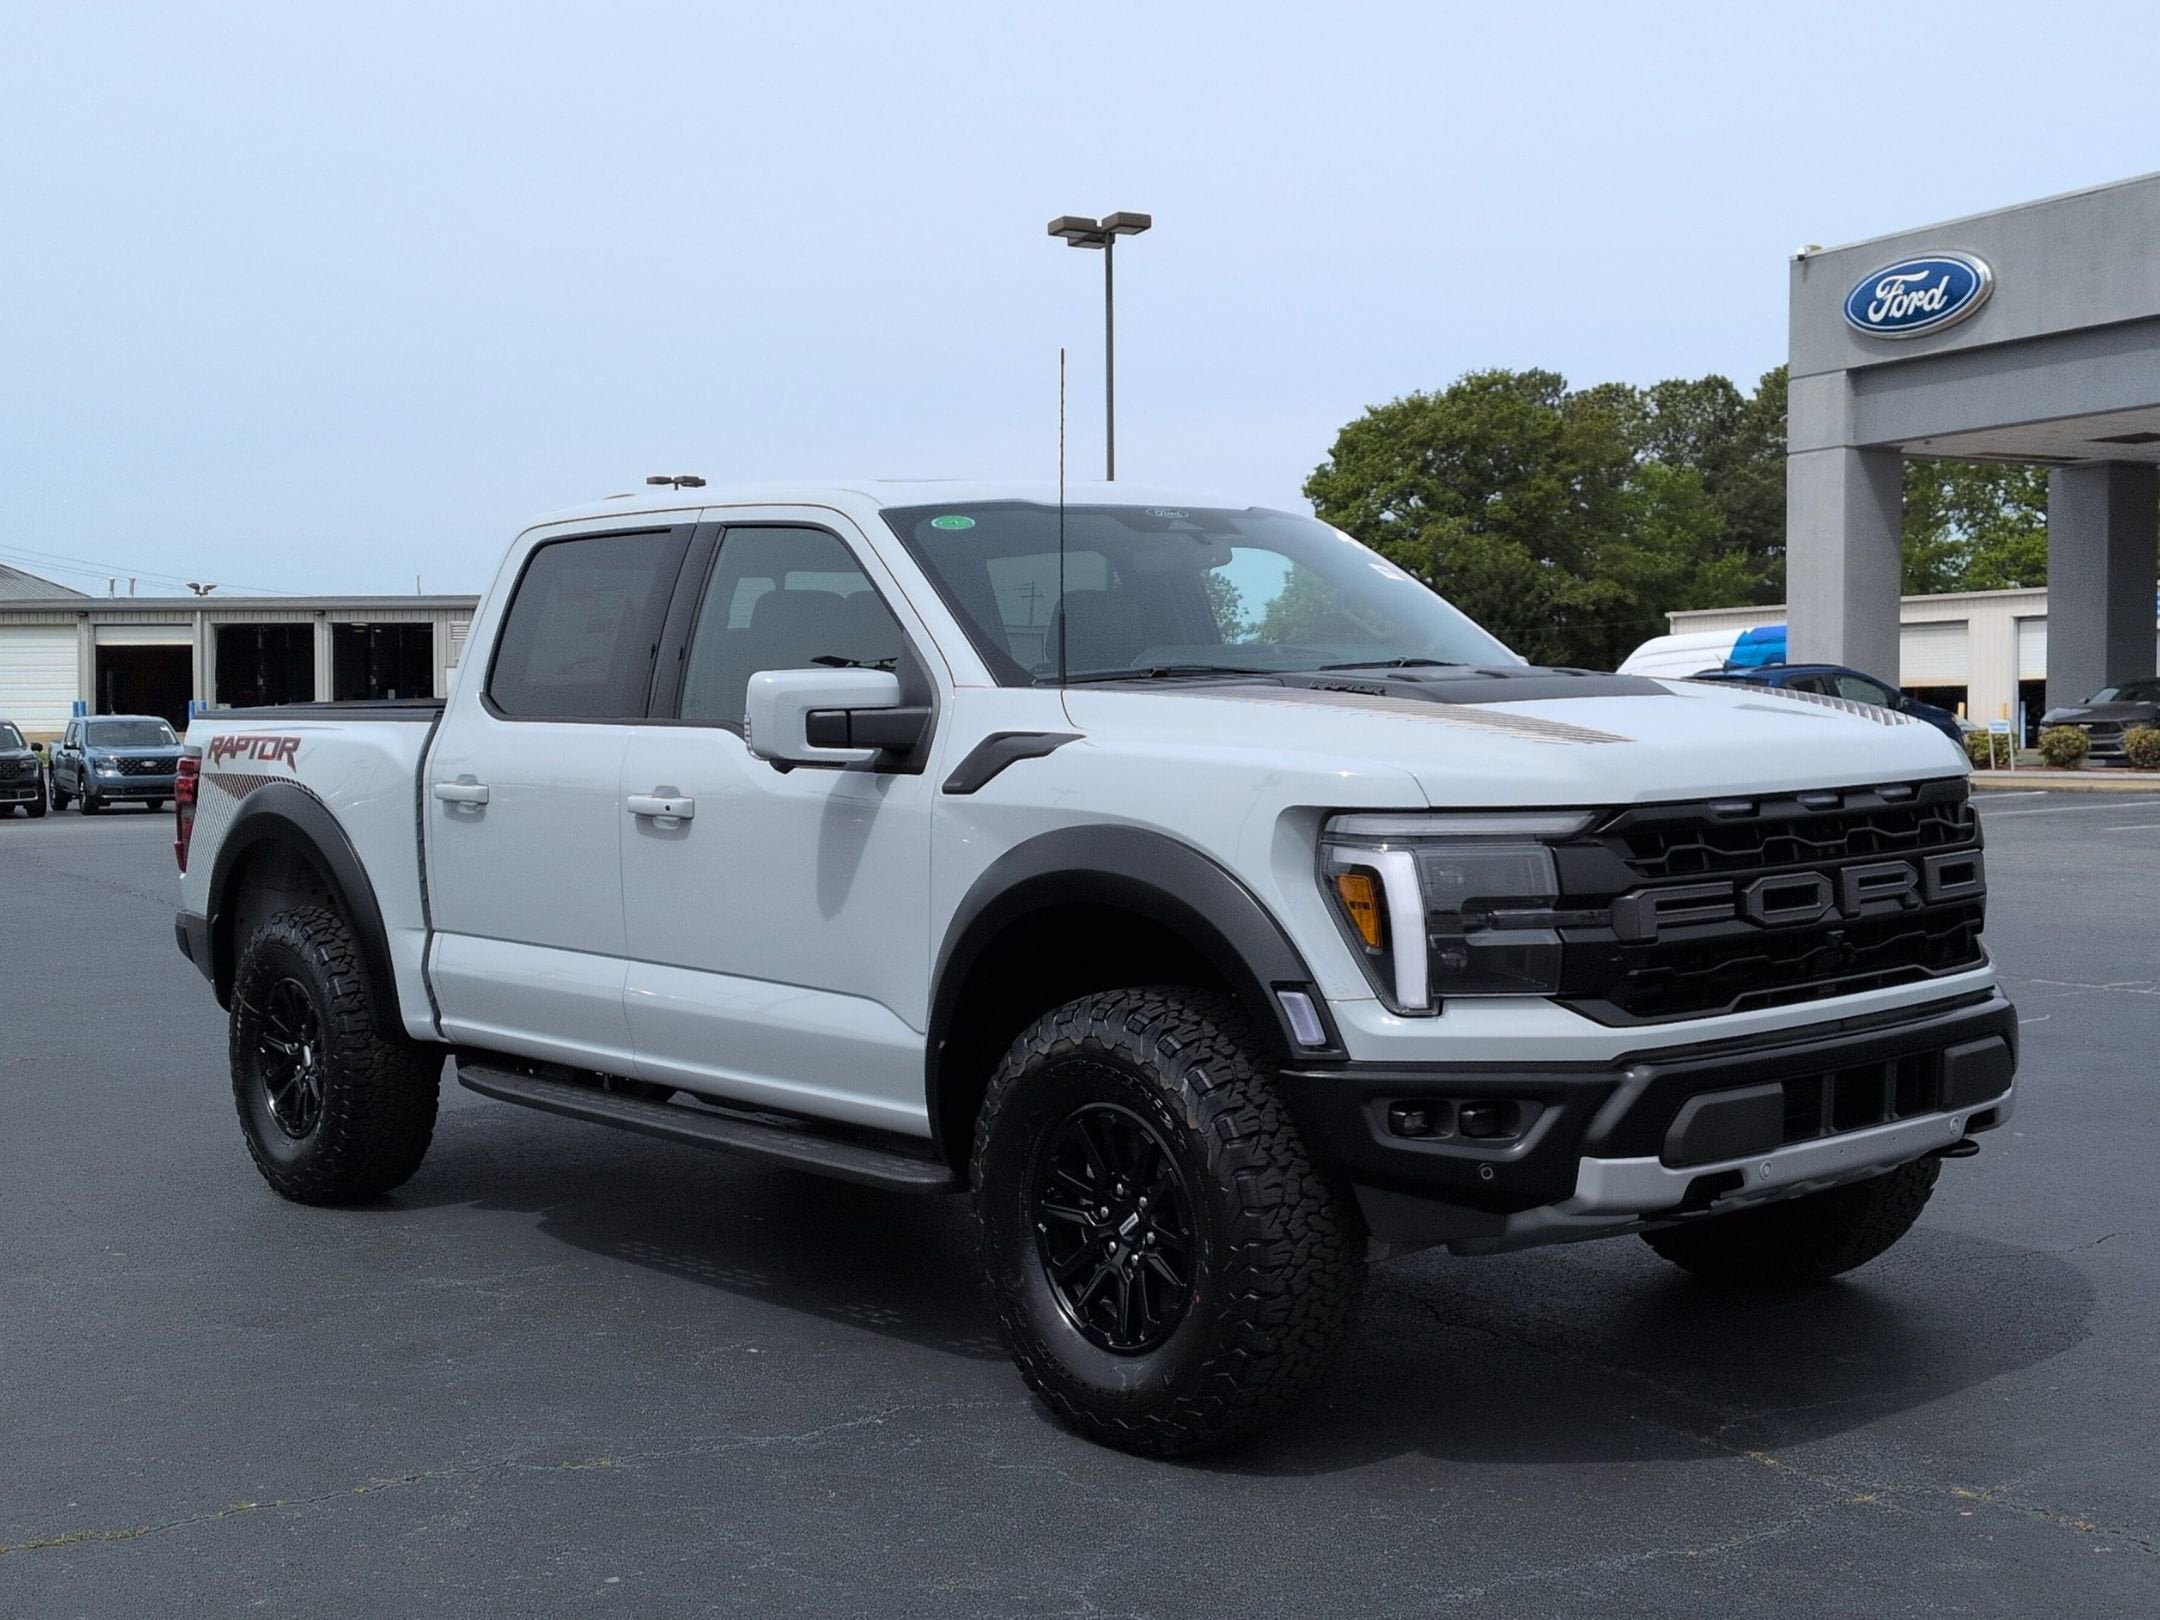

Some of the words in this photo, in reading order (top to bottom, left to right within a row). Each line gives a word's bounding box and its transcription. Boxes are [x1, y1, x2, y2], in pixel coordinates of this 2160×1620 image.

[1867, 270, 1950, 322] Ford
[208, 736, 301, 774] RAPTOR
[1614, 850, 1986, 945] FORD
